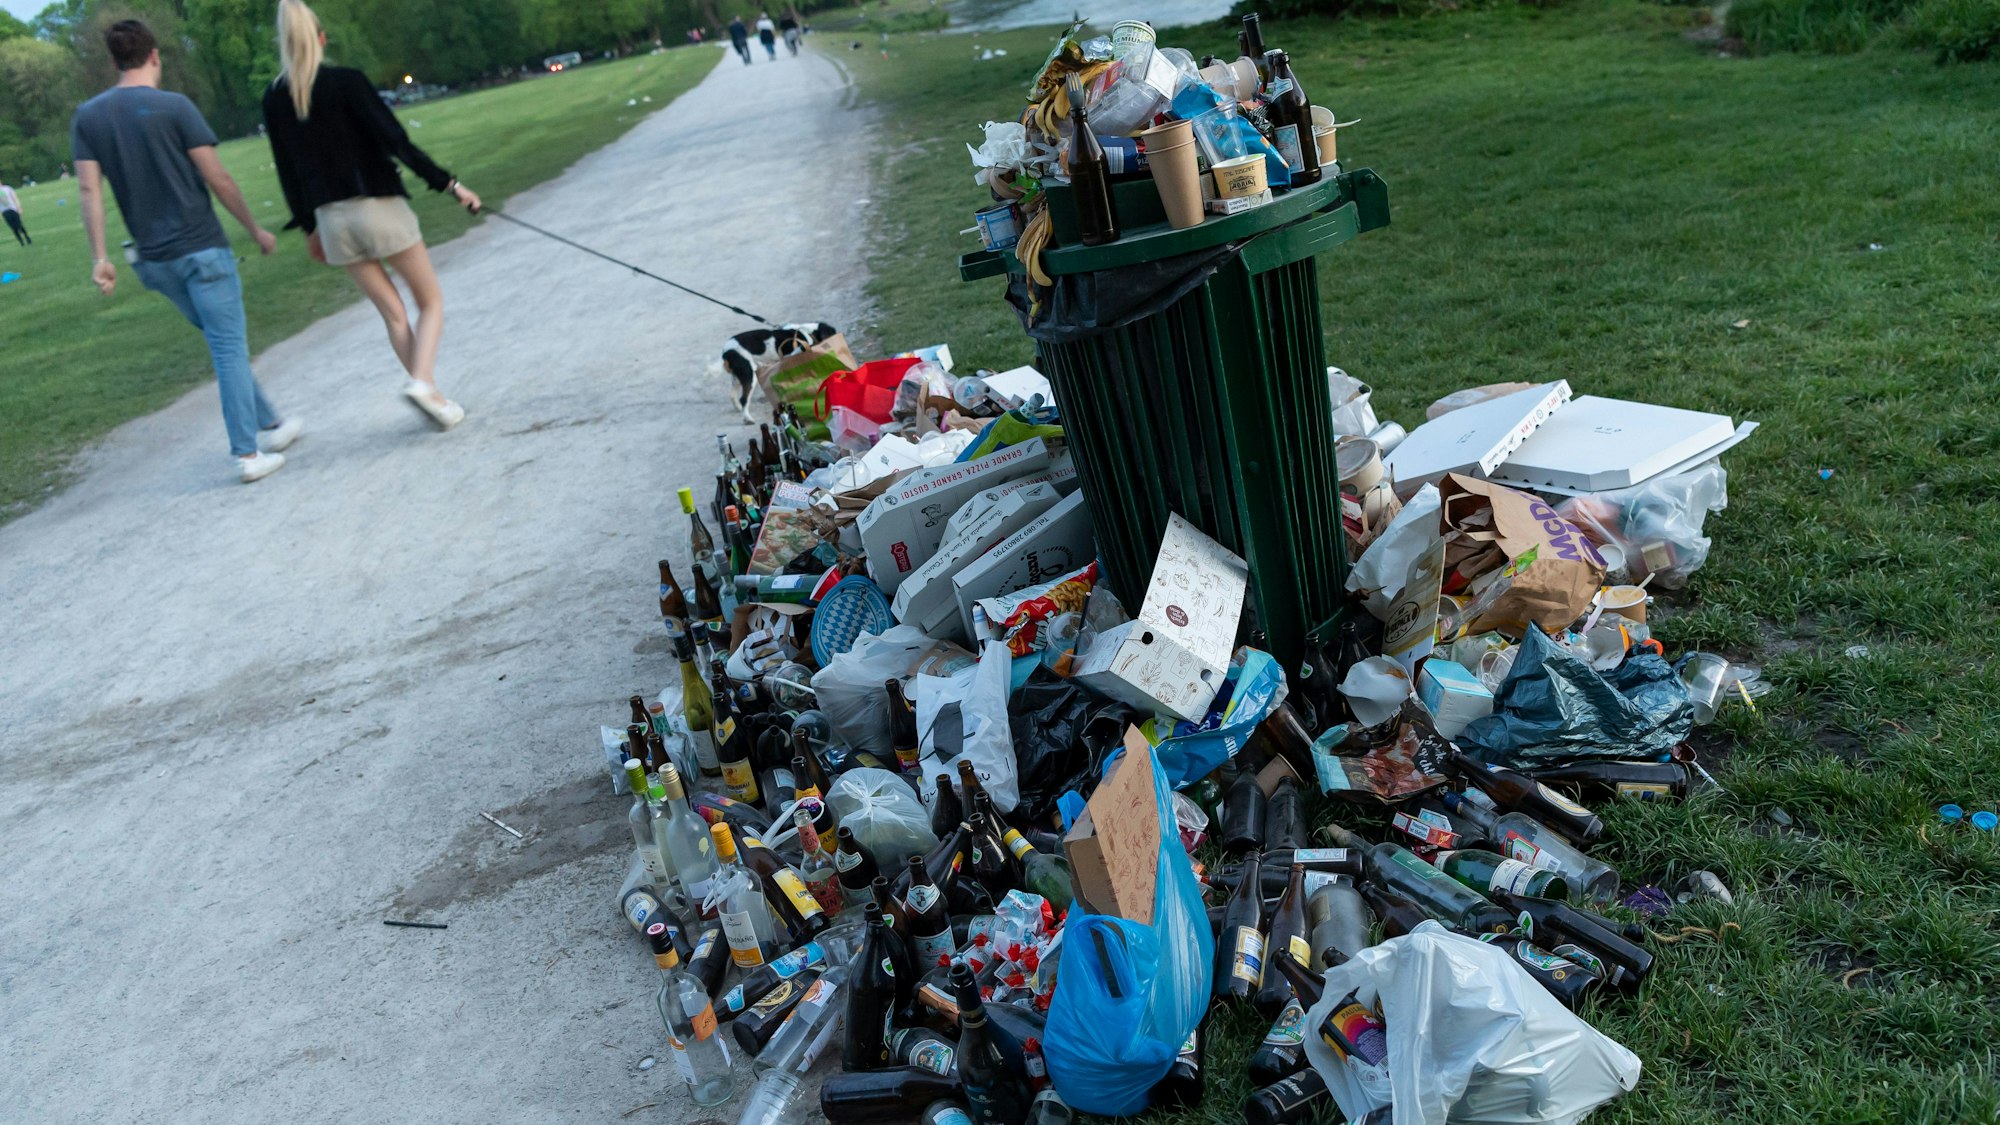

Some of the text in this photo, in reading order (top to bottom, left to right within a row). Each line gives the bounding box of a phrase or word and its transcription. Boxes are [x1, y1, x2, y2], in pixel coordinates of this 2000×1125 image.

[901, 449, 1023, 500] GRANDE PIZZA, GRANDE GUSTO!
[993, 516, 1051, 559] Tel.: 089 28803795
